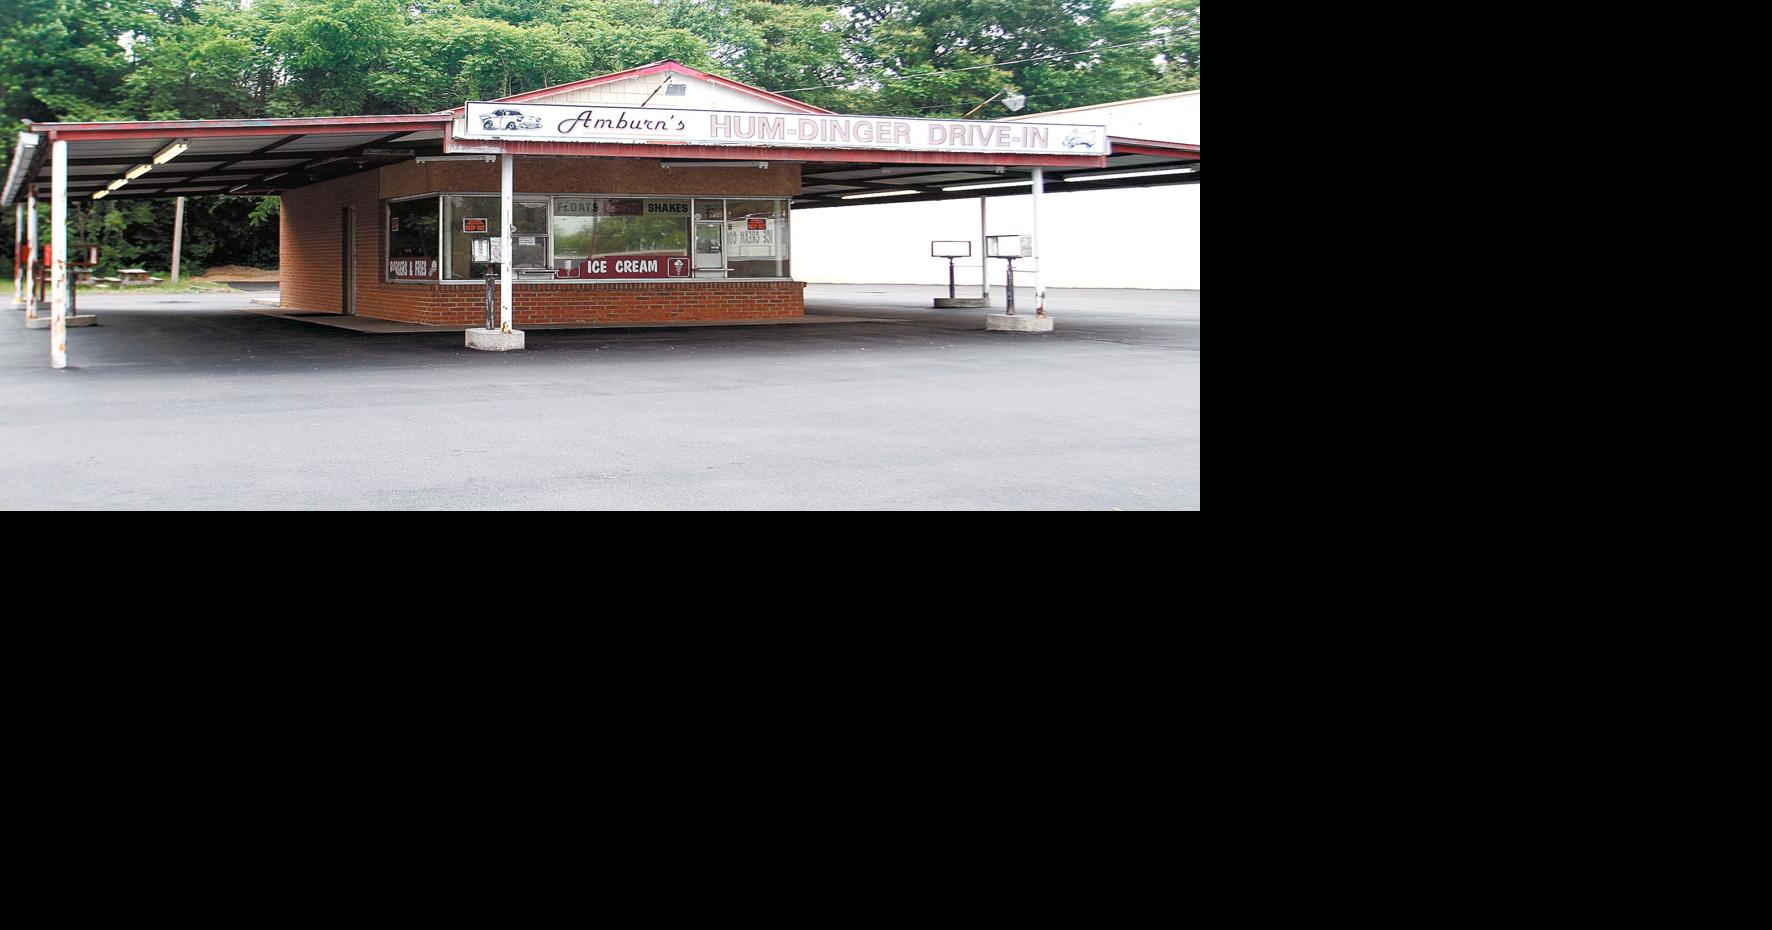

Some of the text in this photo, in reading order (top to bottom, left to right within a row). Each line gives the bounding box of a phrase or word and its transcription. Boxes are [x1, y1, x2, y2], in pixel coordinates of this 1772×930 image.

[557, 110, 1049, 149] Amburn's HUM-DINGER DRIVE-IN
[557, 202, 598, 213] FLOATS
[648, 203, 688, 213] SHAKES
[587, 259, 658, 274] ICE CREAM
